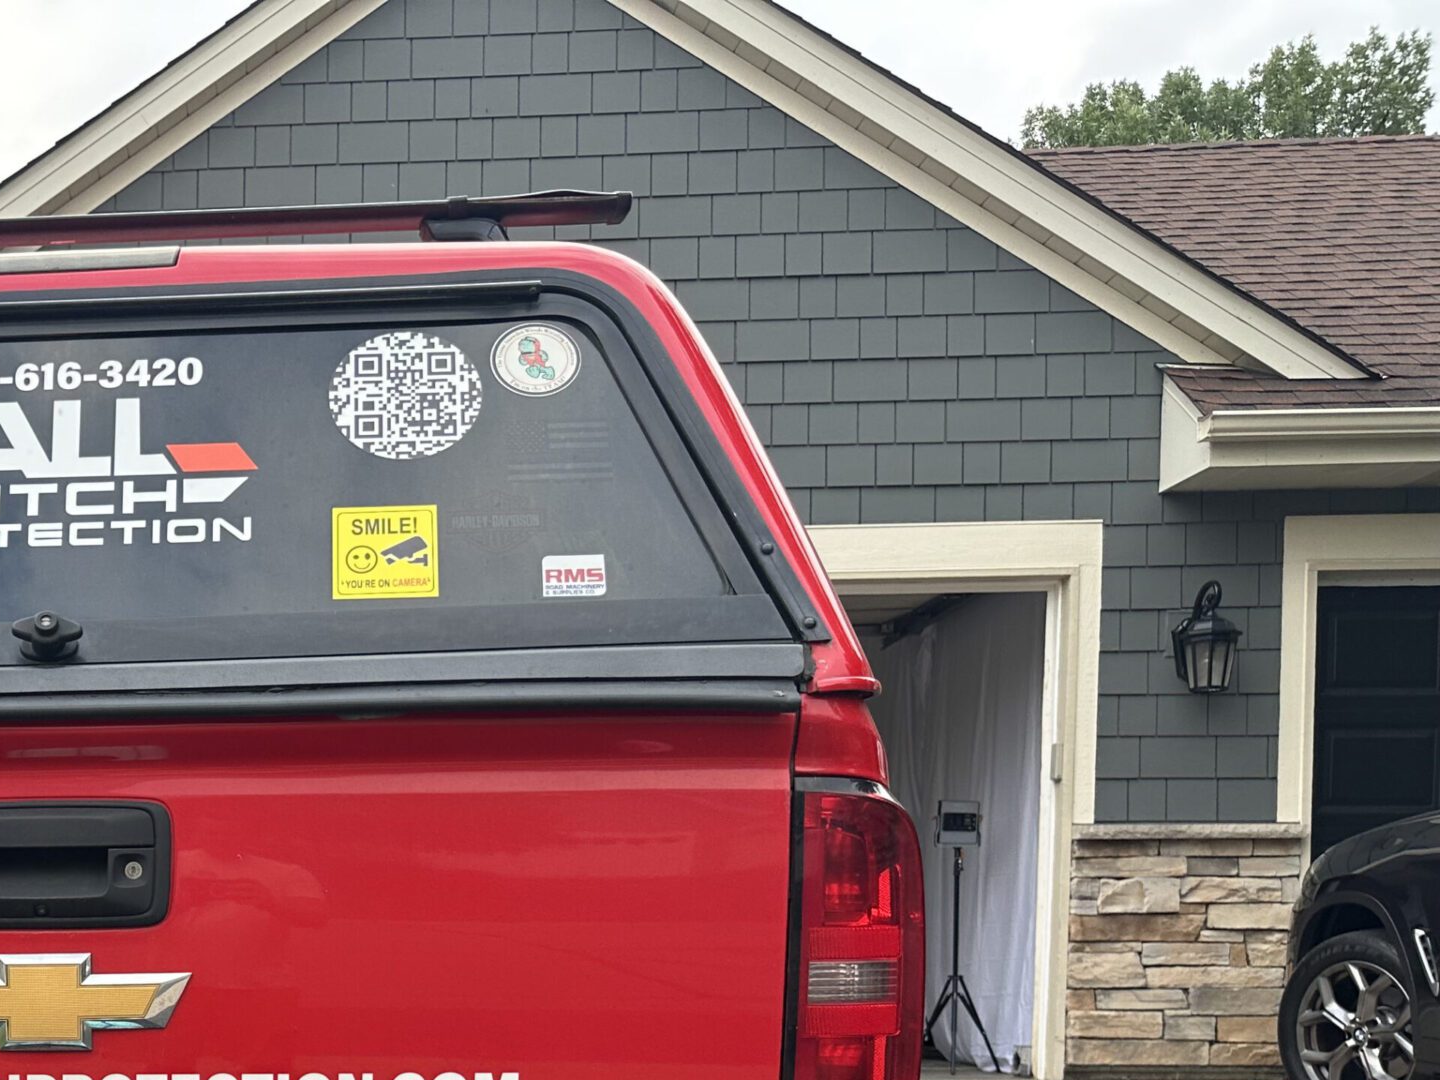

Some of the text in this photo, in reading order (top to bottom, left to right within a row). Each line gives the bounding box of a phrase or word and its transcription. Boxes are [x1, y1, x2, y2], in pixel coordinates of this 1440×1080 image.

[352, 517, 417, 536] SMILE!
[378, 579, 390, 587] ON
[544, 567, 604, 583] RMS
